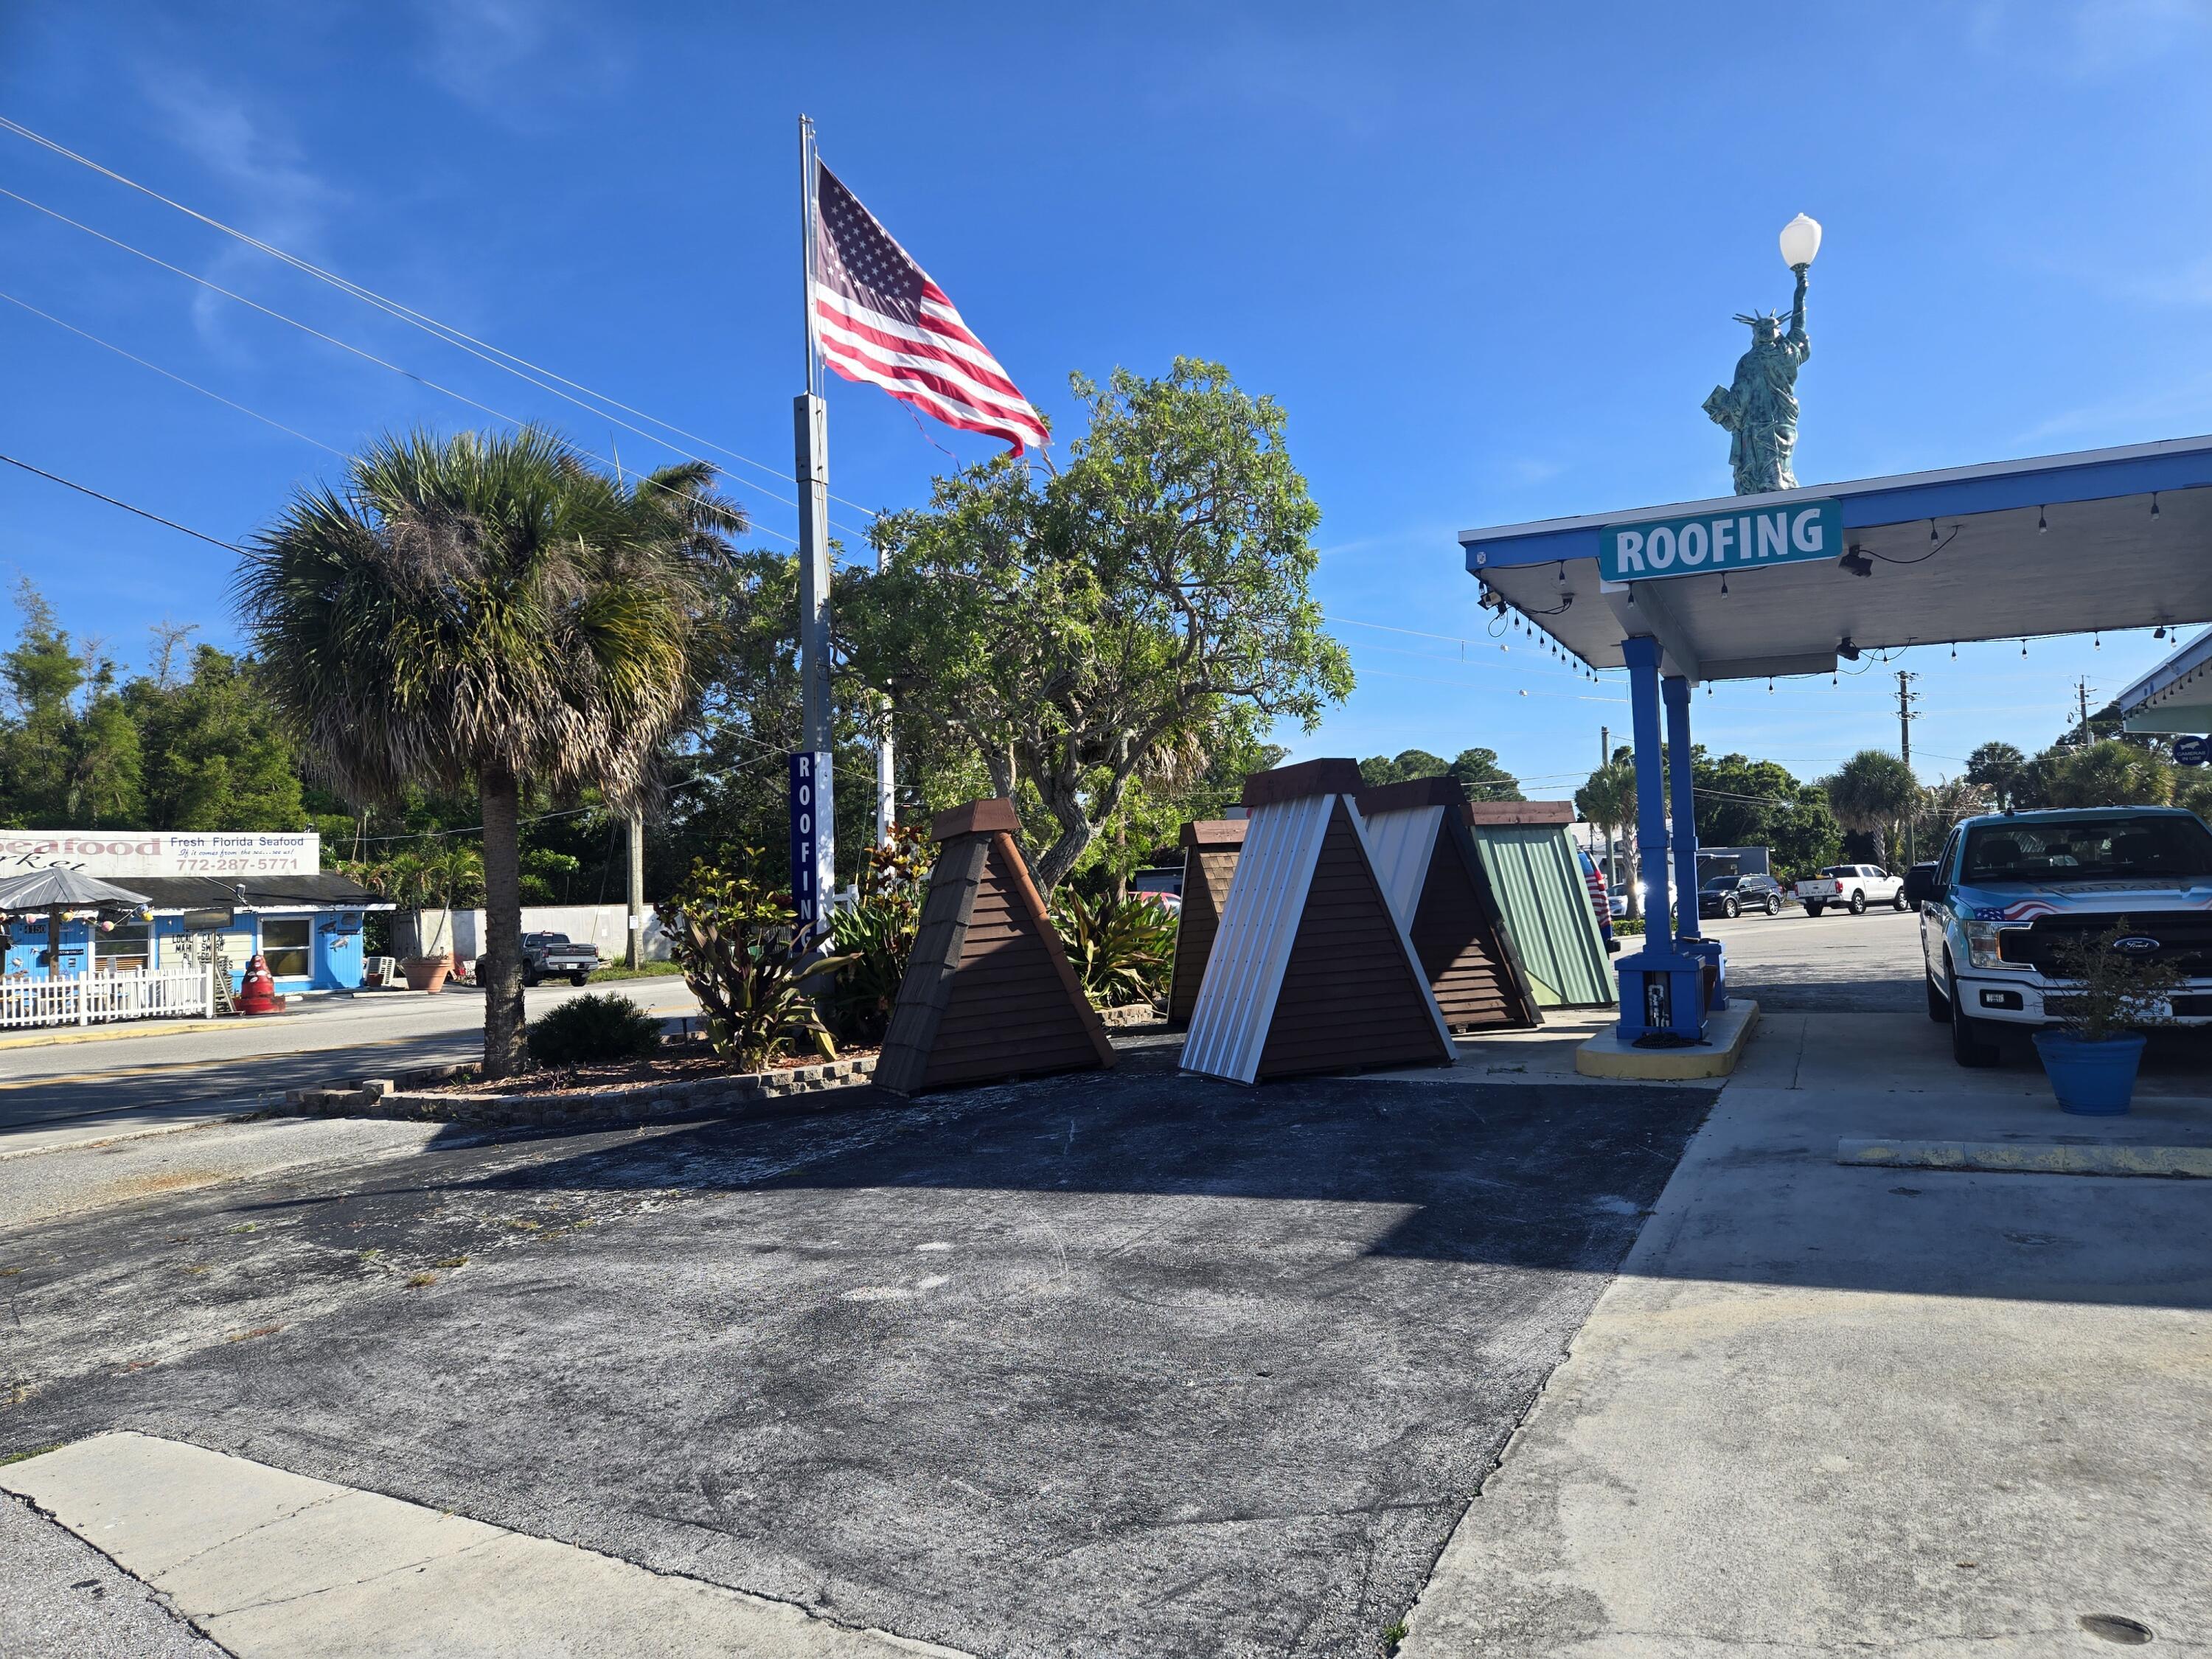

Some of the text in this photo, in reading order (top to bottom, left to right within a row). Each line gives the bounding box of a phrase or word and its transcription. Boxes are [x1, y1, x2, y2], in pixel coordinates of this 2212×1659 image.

[1617, 509, 1823, 572] ROOFING
[0, 838, 162, 855] eafood
[170, 837, 304, 846] Fresh Florida Seafood
[178, 849, 189, 858] If
[220, 849, 237, 858] from
[799, 757, 811, 947] ROOFING
[176, 858, 297, 871] 772-287-5771
[173, 934, 193, 943] LOCAL
[201, 943, 223, 952] SWRD
